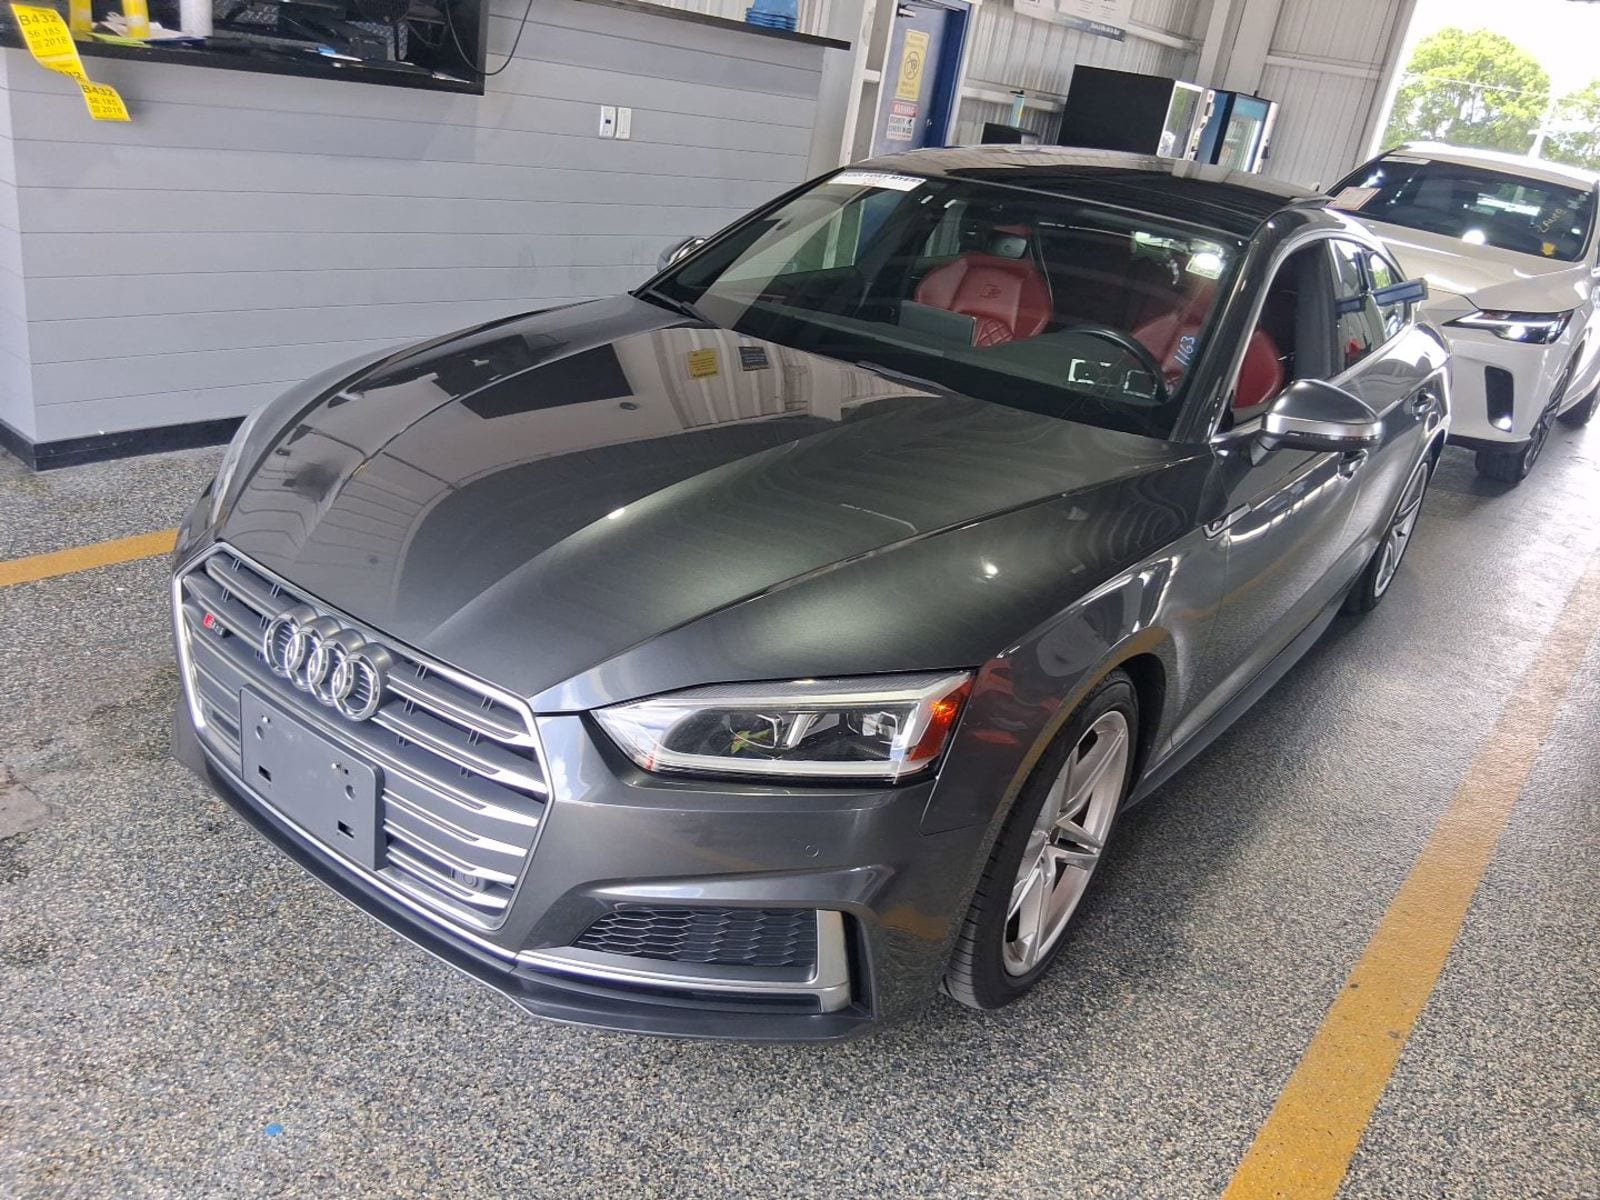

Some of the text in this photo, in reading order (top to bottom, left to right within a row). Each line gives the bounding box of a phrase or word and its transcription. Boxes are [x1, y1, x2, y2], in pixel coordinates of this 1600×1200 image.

[18, 13, 58, 25] B432
[81, 84, 116, 97] B432
[1174, 336, 1196, 366] 1163
